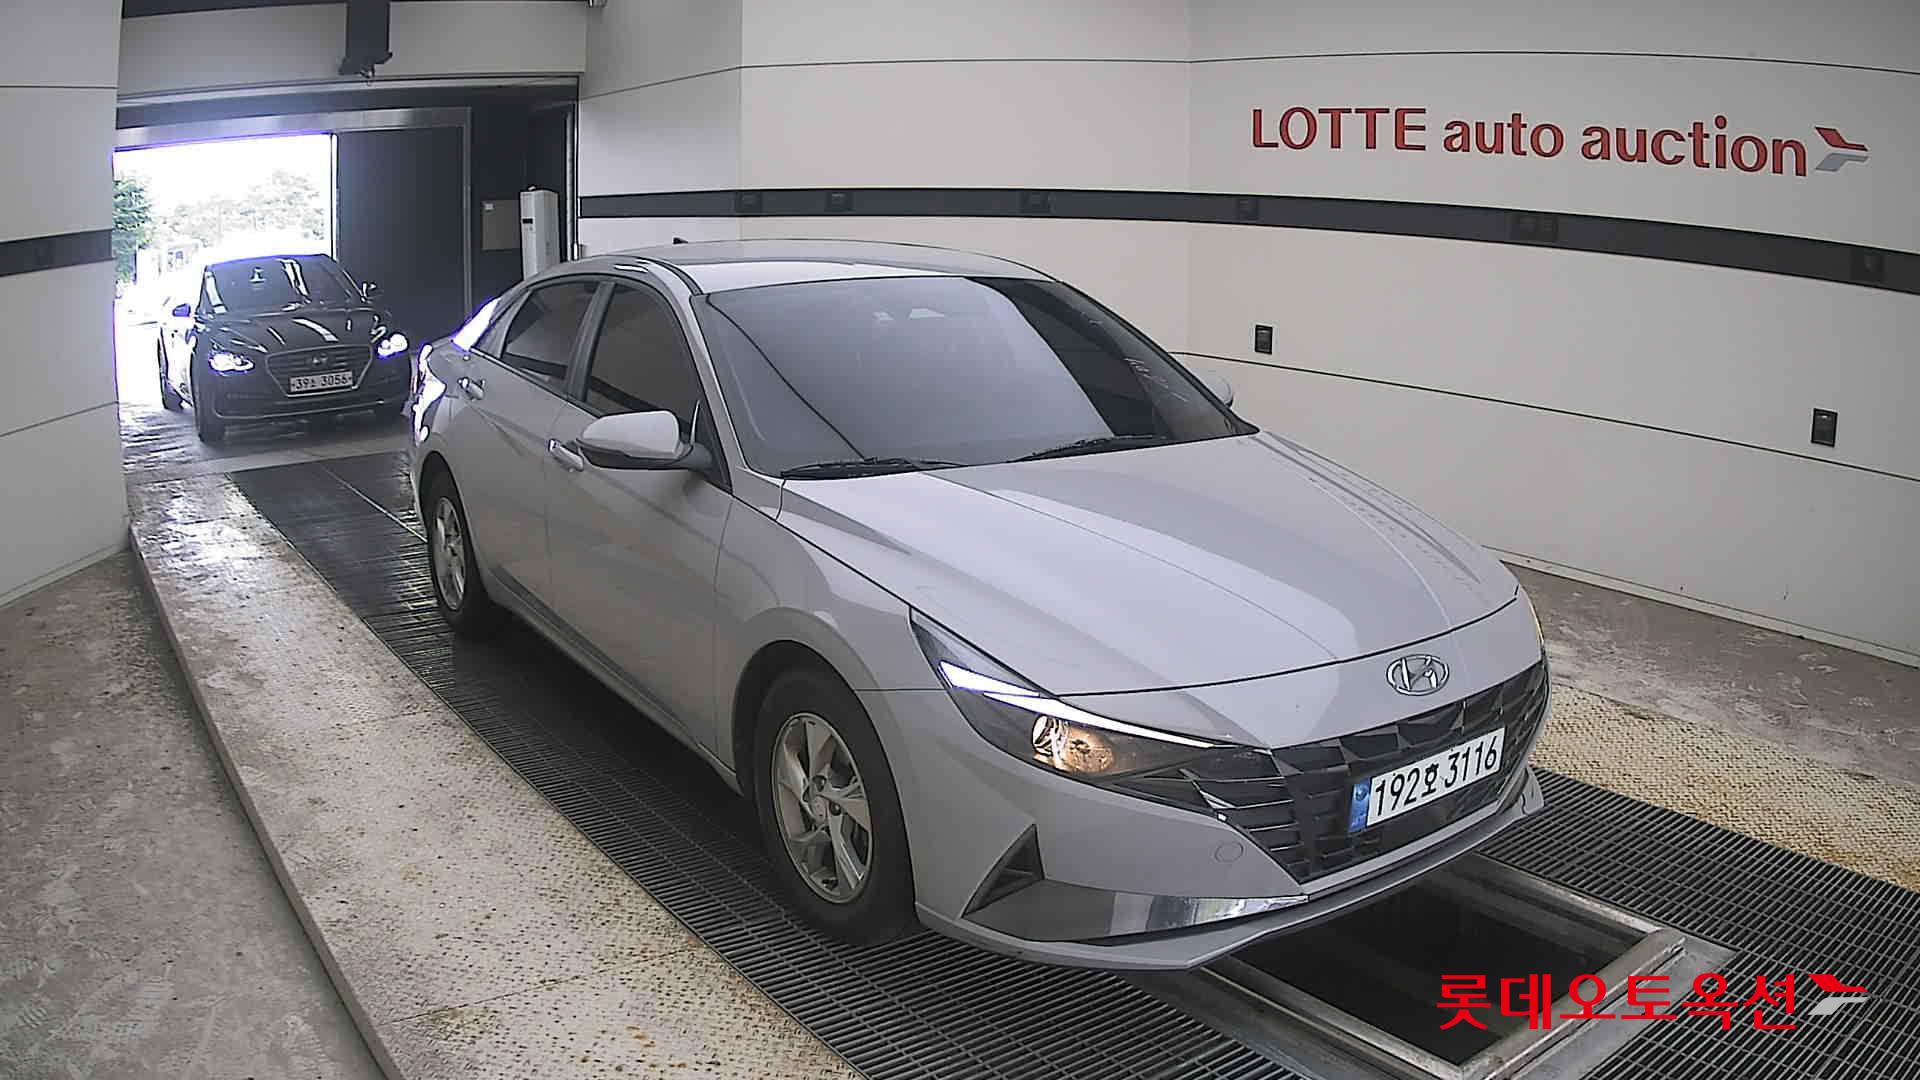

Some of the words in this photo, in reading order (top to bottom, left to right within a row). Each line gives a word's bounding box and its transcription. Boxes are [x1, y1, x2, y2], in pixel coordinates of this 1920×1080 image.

[1252, 107, 1427, 151] LOTTE
[1443, 112, 1563, 157] auto
[1581, 115, 1807, 177] auction
[1375, 764, 1439, 816] 192호
[1444, 735, 1498, 788] 3116
